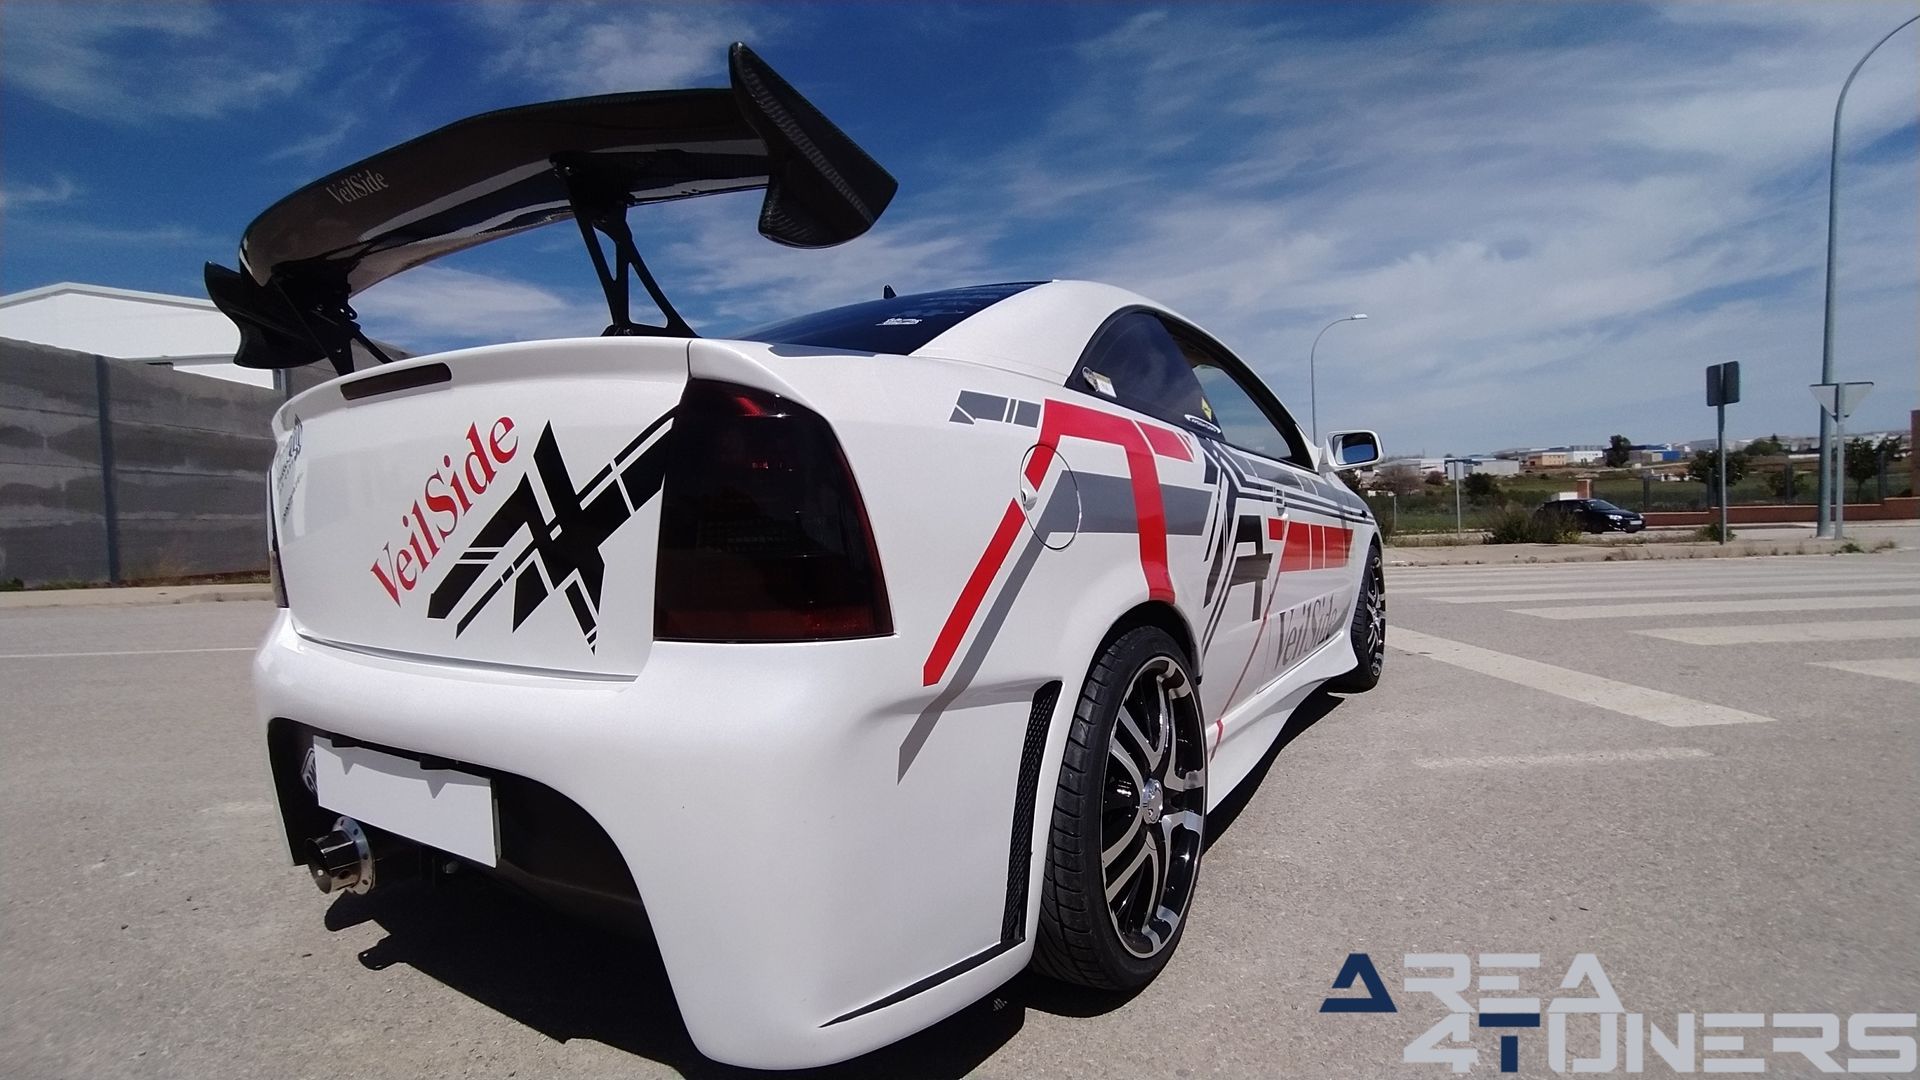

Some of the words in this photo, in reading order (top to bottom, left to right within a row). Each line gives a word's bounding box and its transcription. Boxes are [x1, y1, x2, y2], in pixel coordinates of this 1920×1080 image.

[325, 169, 389, 205] VeilSide
[370, 416, 519, 608] VeilSide
[1275, 593, 1338, 669] VeilSide
